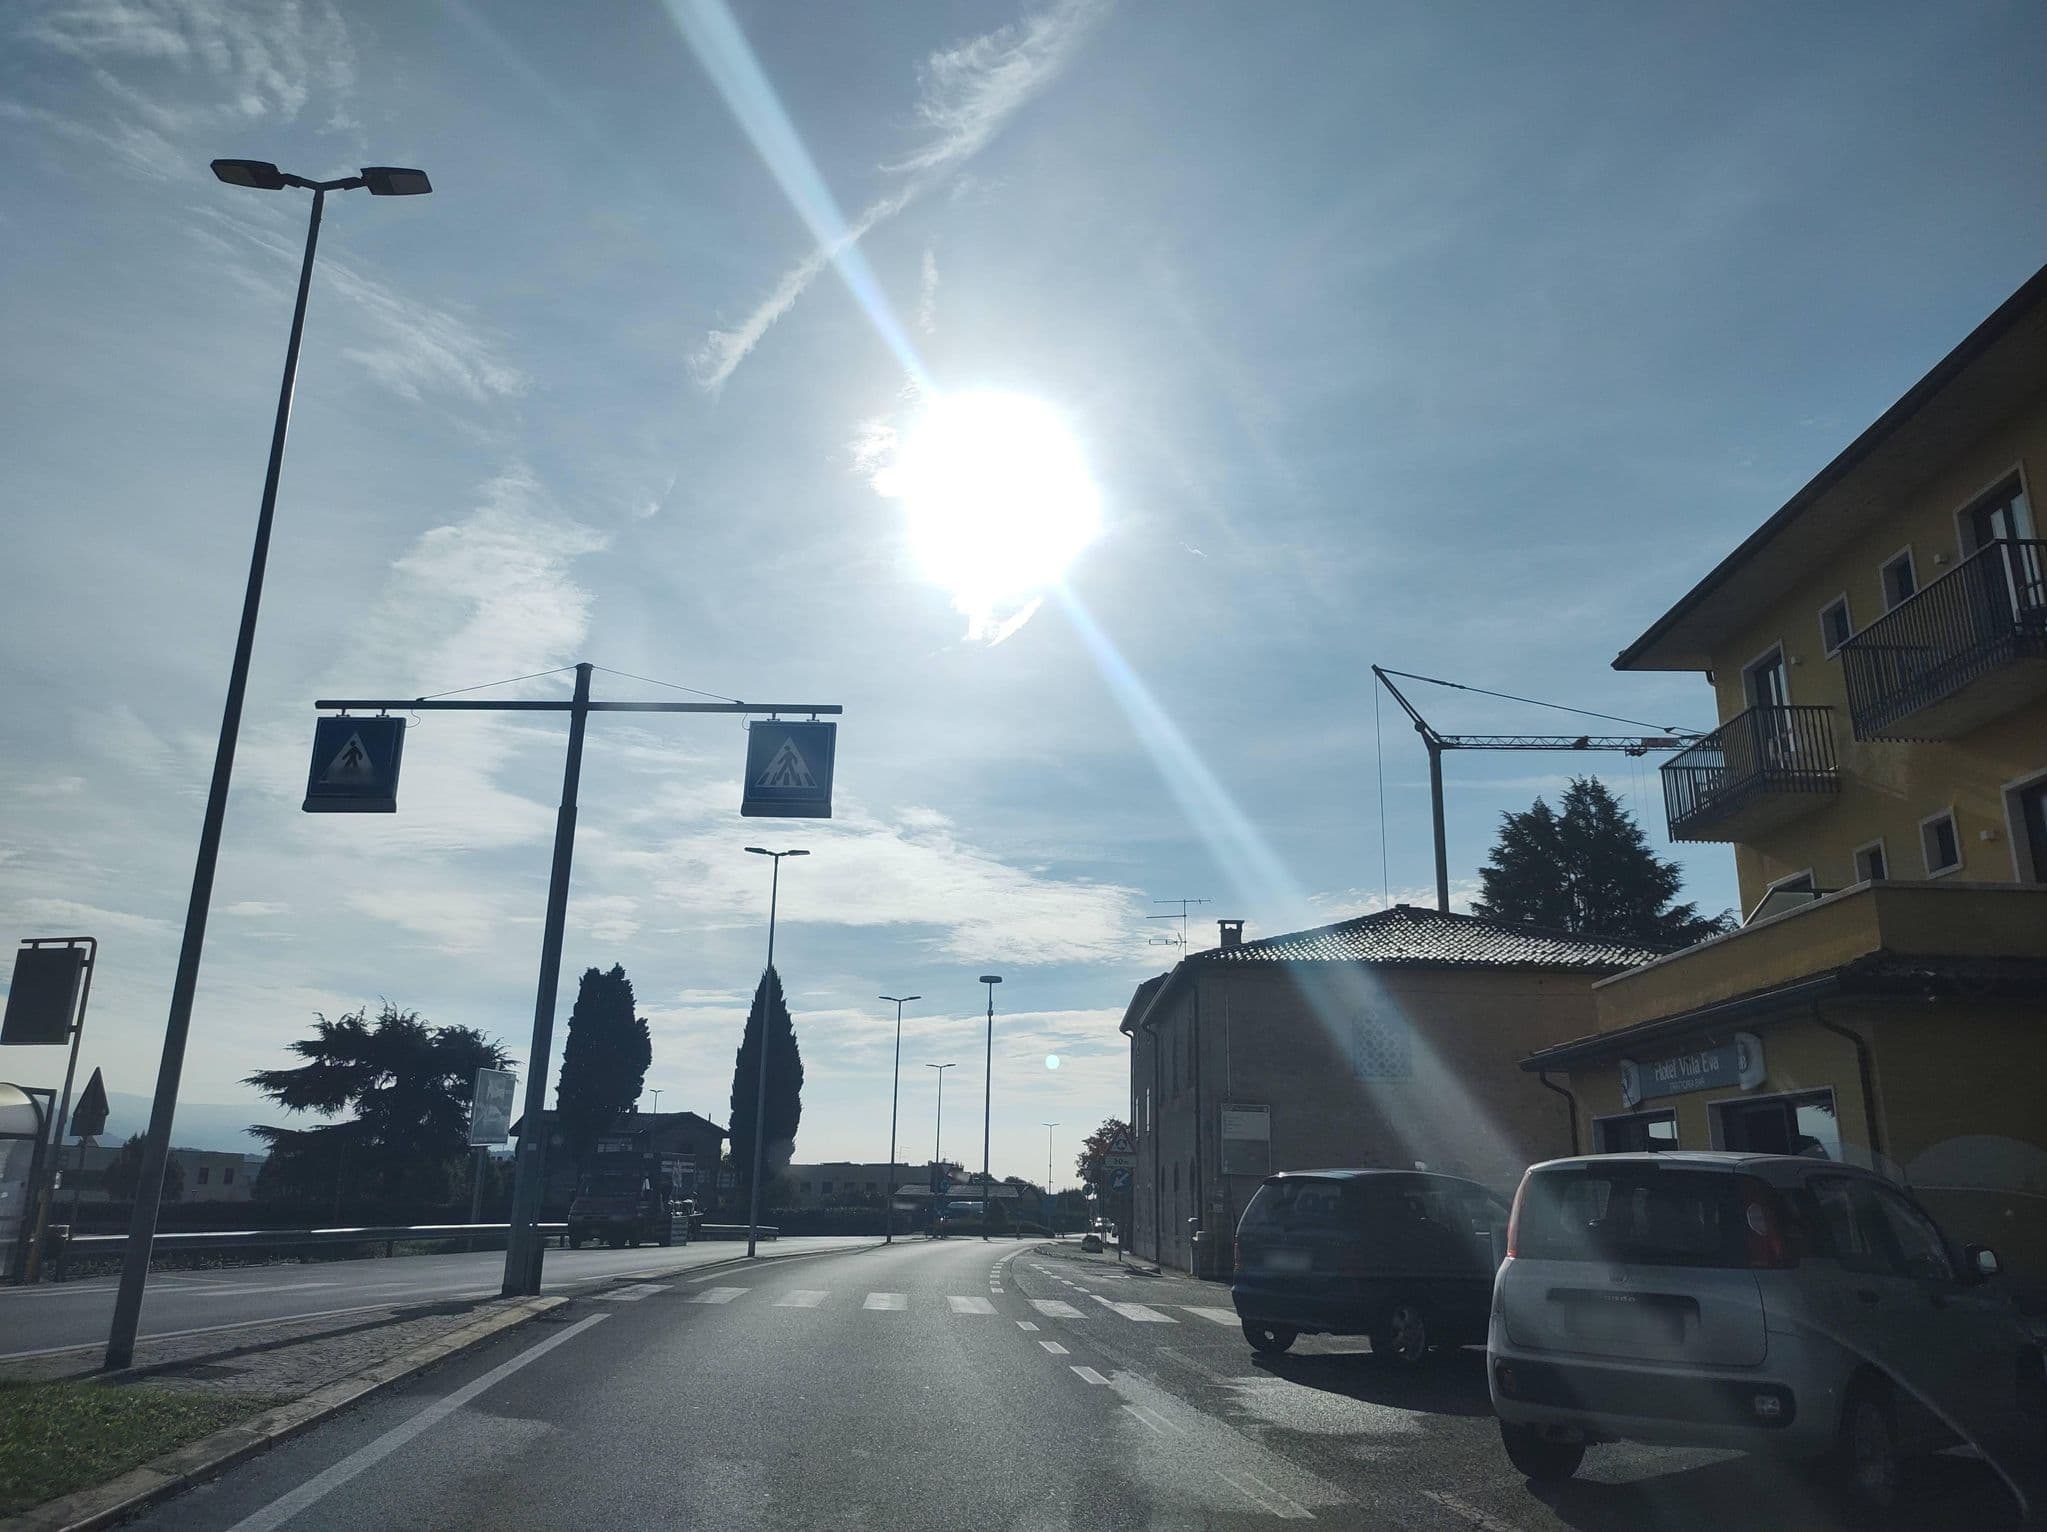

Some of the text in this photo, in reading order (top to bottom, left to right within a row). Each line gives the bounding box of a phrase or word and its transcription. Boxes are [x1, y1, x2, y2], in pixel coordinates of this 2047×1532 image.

[1654, 1052, 1720, 1081] Hotel Villa Eva
